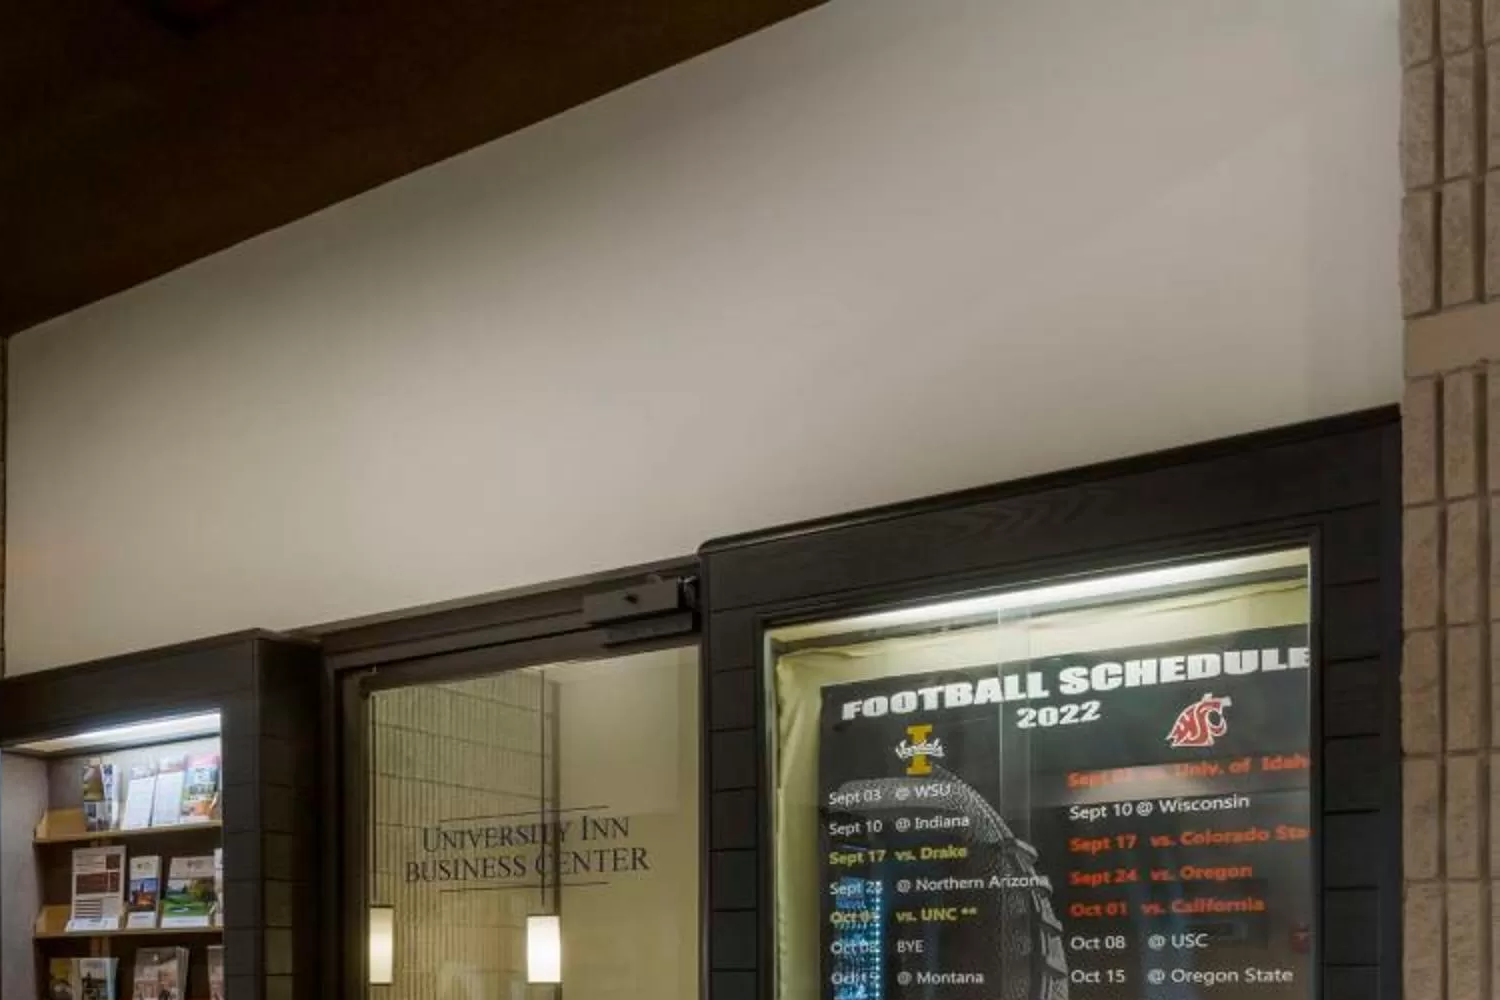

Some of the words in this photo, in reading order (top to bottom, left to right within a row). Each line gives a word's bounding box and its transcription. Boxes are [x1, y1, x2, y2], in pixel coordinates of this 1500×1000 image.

[842, 672, 1049, 720] FOOTBALL
[1058, 647, 1310, 695] SCHEDULE
[1016, 701, 1101, 728] 2022
[1229, 758, 1252, 773] of
[829, 790, 861, 806] Sept
[863, 789, 882, 801] 03
[914, 783, 951, 798] WSU
[1069, 805, 1107, 822] Sept
[1113, 802, 1133, 817] 10
[1136, 801, 1153, 816] @
[1159, 792, 1251, 813] Wisconsin
[422, 819, 572, 853] UNIVERSITY
[580, 814, 630, 841] INN
[829, 821, 861, 837] Sept
[866, 819, 883, 833] 10
[895, 818, 911, 832] @
[915, 815, 971, 830] Indiana
[1069, 837, 1110, 855] Sept
[1116, 834, 1138, 849] 17
[1180, 827, 1269, 846] Colorado
[404, 856, 527, 884] BUSINESS
[534, 847, 650, 877] CENTER
[829, 851, 864, 867] Sept
[868, 849, 887, 863] 17
[895, 849, 917, 861] vs.
[920, 845, 968, 860] Drake
[896, 879, 911, 893] @
[916, 875, 984, 891] Northern
[988, 874, 1050, 889] Arizona
[1069, 870, 1110, 887] Sept
[1115, 867, 1137, 882] 24
[1180, 864, 1253, 882] Oregon
[895, 910, 917, 922] vs.
[921, 908, 957, 921] UNC
[1070, 903, 1102, 917] Oct
[1107, 903, 1128, 916] 01
[1171, 897, 1266, 914] California
[896, 939, 925, 953] BYE
[1070, 935, 1101, 949] Oct
[1105, 935, 1126, 949] 08
[1148, 934, 1166, 950] @
[1171, 933, 1210, 948] USC
[897, 971, 912, 985] @
[916, 970, 985, 985] Montana
[1070, 969, 1101, 984] Oct
[1107, 969, 1126, 983] 15
[1148, 969, 1165, 984] @
[1171, 968, 1239, 986] Oregon
[1244, 967, 1294, 984] State
